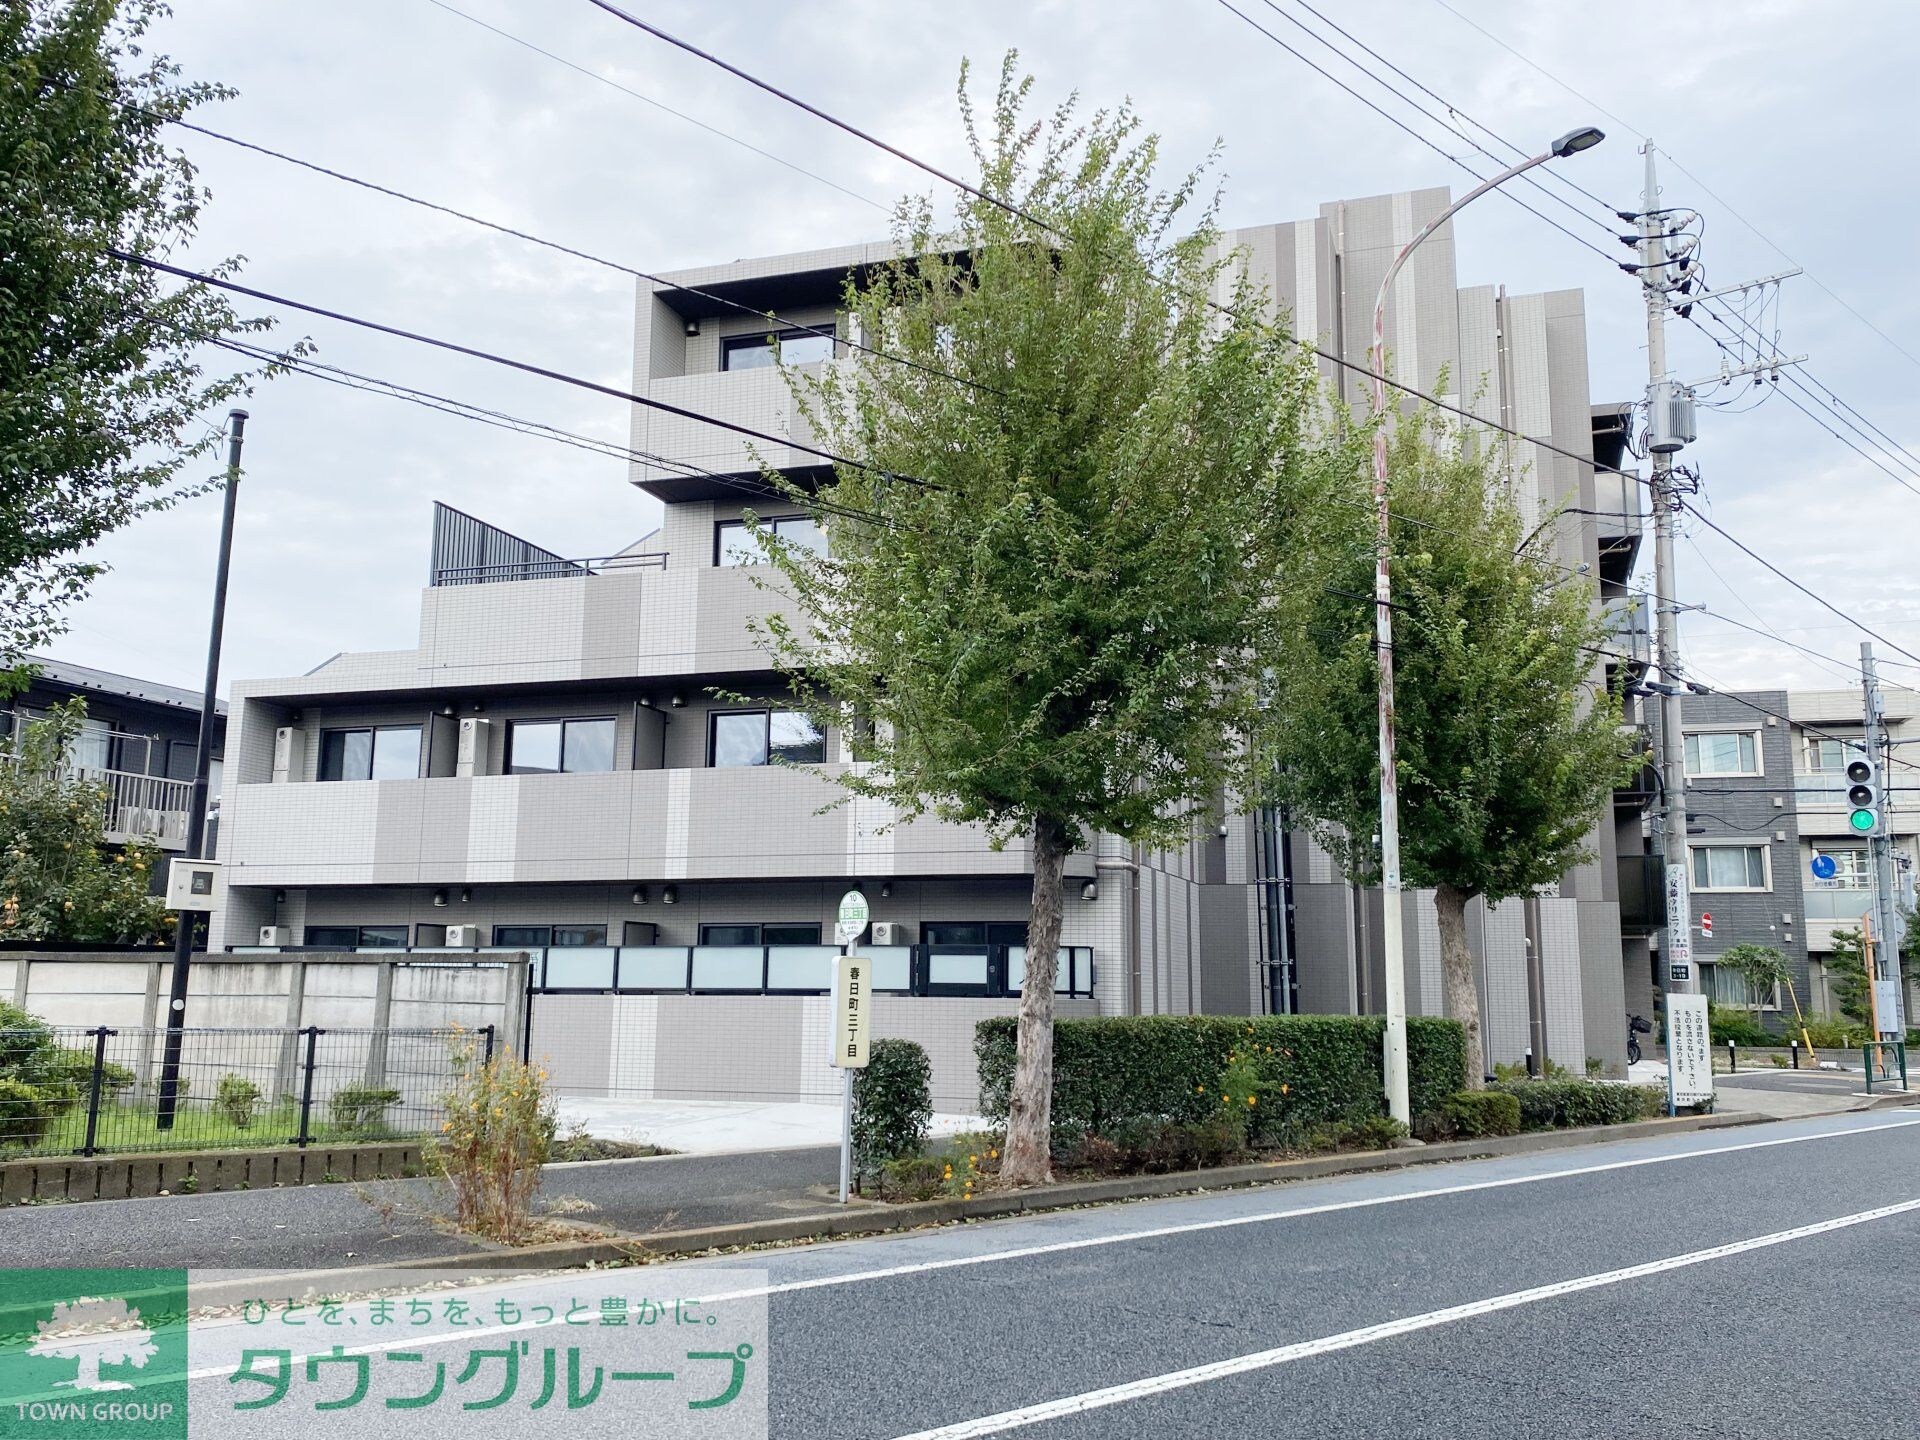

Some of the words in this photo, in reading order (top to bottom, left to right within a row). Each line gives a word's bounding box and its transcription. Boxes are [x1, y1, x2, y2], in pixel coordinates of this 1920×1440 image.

[847, 966, 861, 1058] 春日町三丁目
